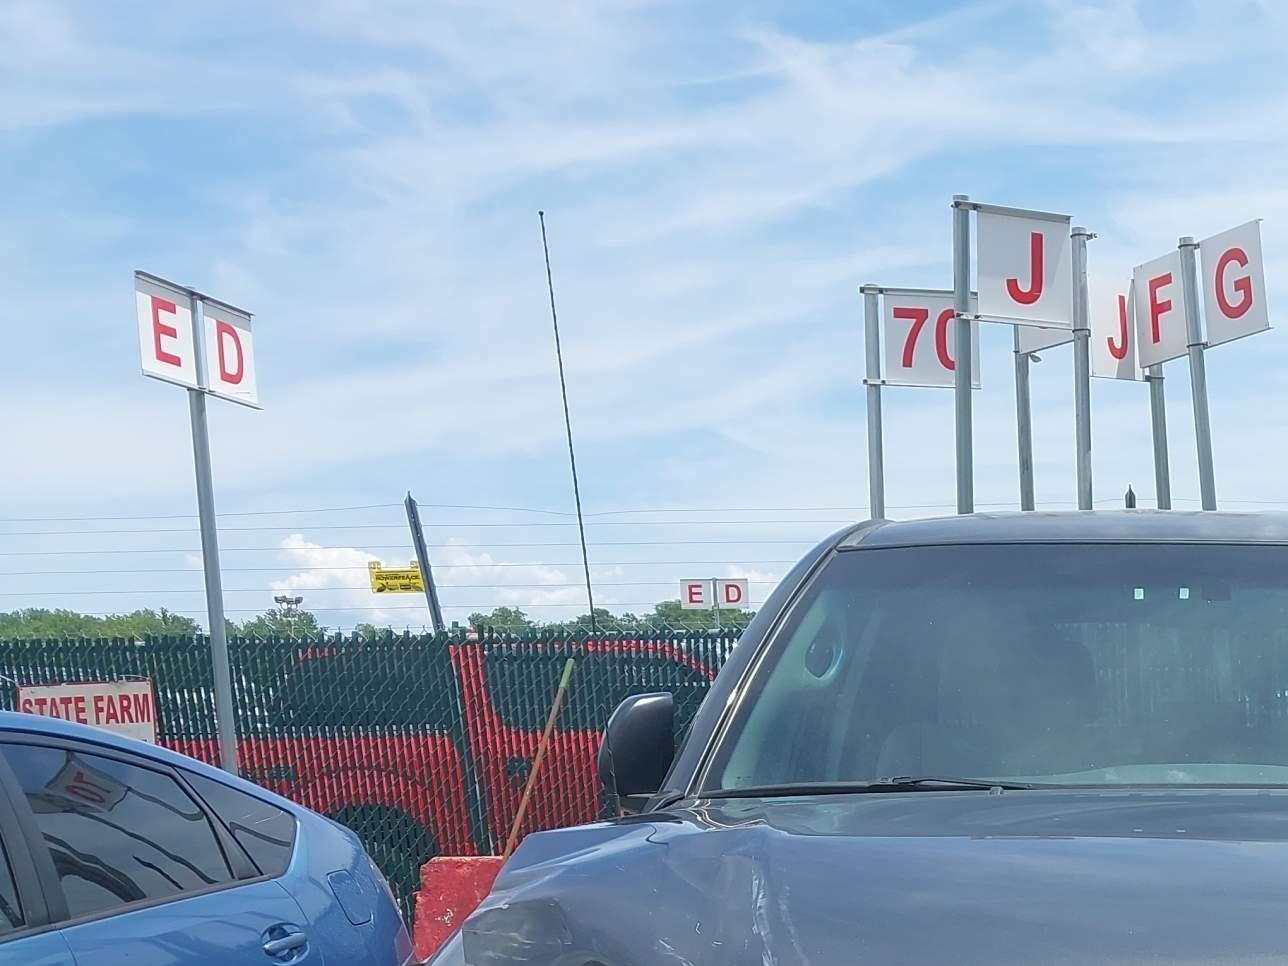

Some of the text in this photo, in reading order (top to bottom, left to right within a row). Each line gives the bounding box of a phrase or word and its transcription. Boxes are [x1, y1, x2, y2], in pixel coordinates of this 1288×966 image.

[1006, 231, 1044, 306] J
[1214, 246, 1254, 319] G
[150, 296, 182, 368] E
[1106, 294, 1128, 360] J
[1148, 271, 1173, 345] F
[215, 319, 244, 385] D
[687, 583, 704, 604] E
[724, 583, 742, 604] D
[22, 693, 151, 725] STATE FARM
